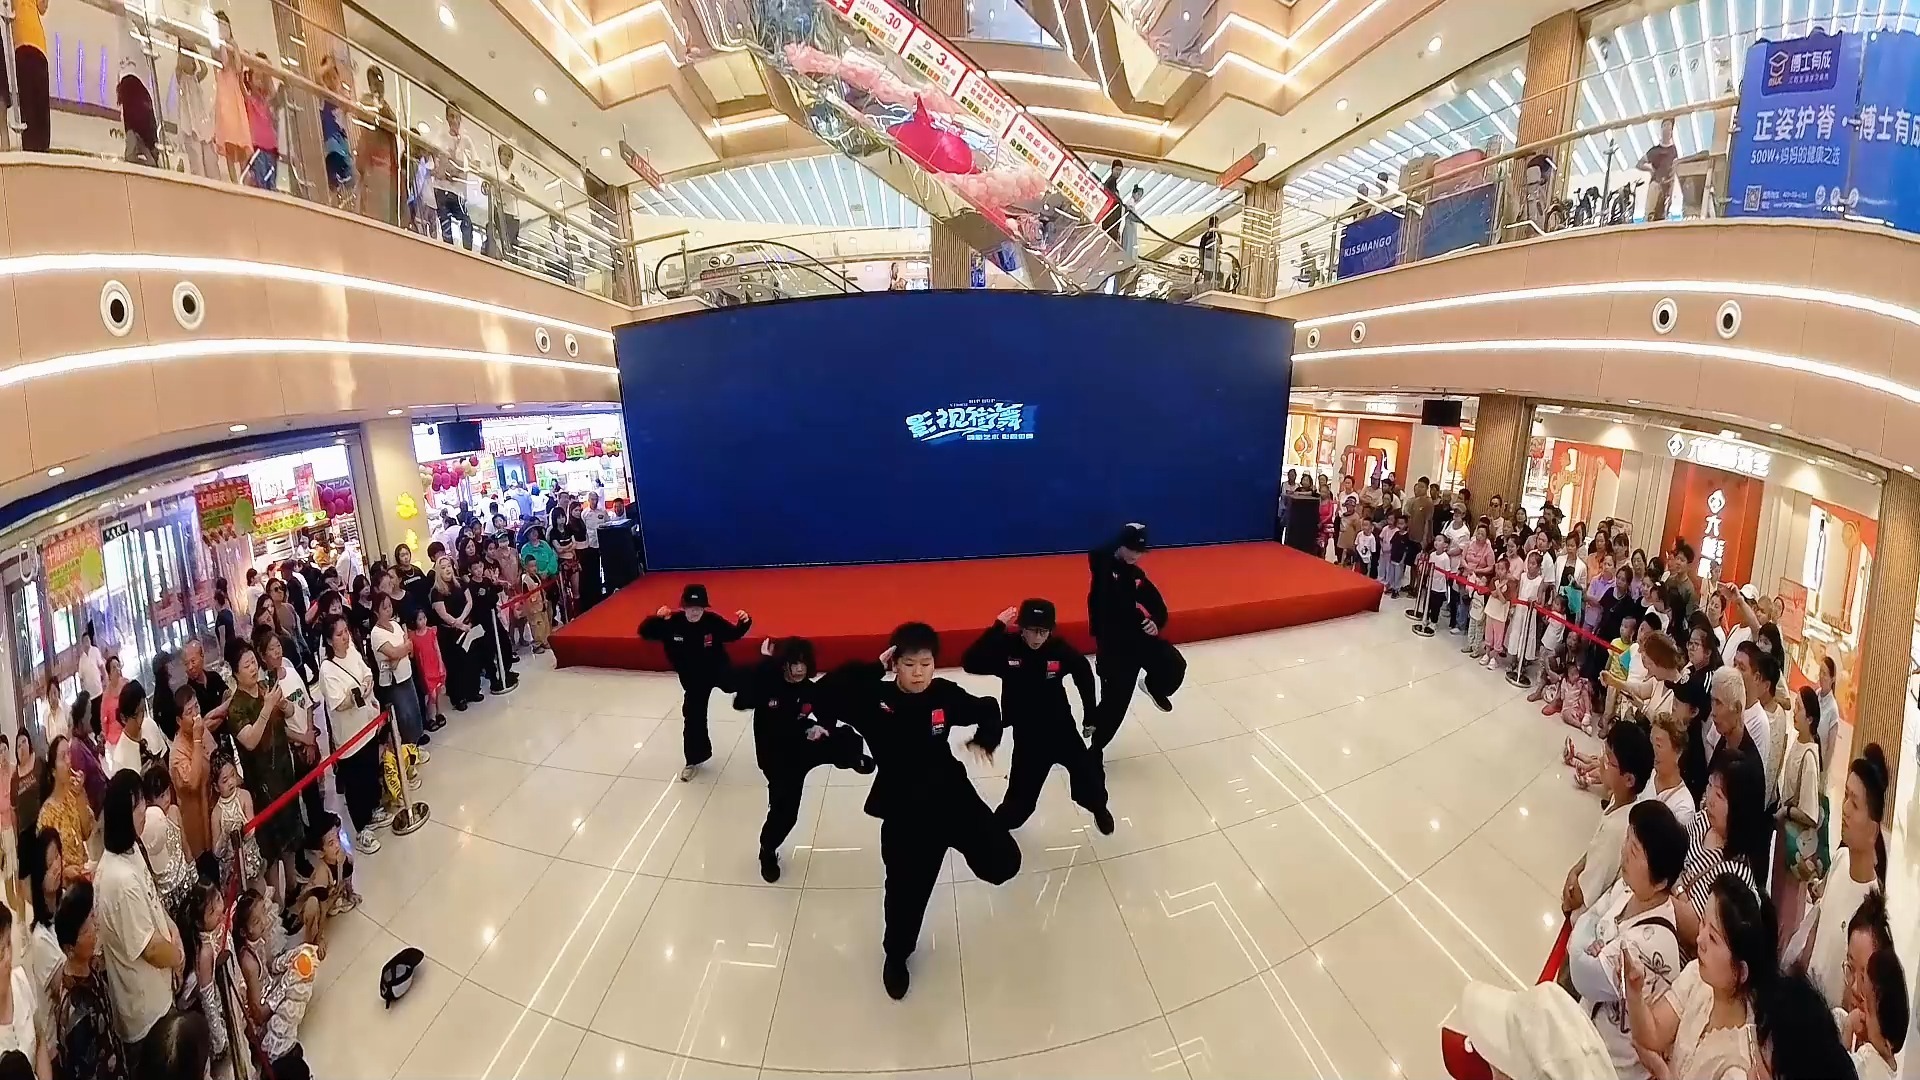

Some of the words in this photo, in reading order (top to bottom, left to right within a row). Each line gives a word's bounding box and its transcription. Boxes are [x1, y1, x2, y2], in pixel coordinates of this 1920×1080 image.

[1790, 50, 1832, 73] 博士有成
[1344, 236, 1392, 257] KISSMANGO
[905, 402, 1023, 438] 影视街舞
